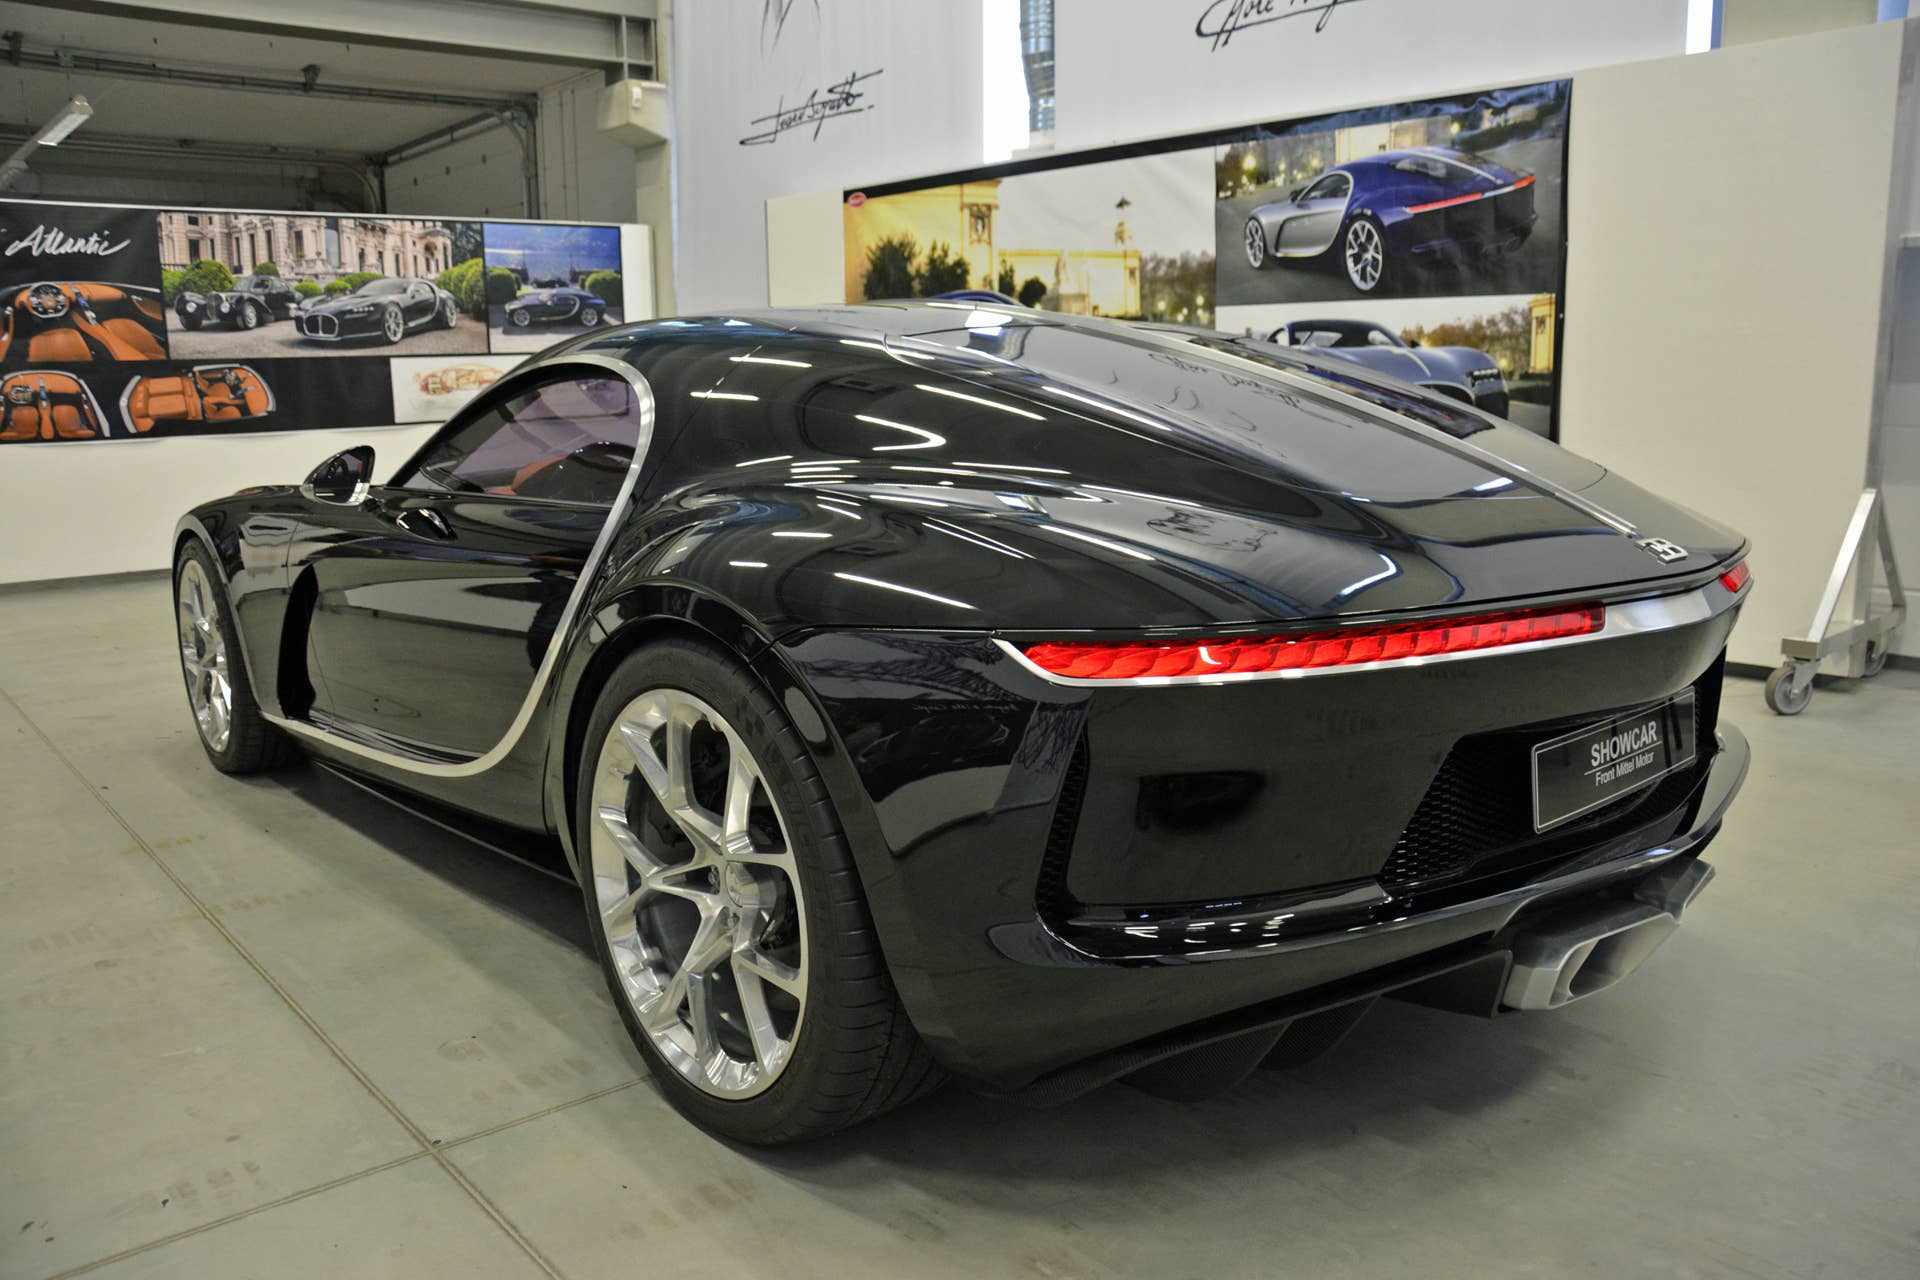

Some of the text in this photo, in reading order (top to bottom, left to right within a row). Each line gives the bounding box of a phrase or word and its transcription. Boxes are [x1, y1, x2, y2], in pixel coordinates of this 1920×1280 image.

[4, 224, 131, 257] Atlantic
[1591, 720, 1657, 767] SHOWCAR
[1595, 751, 1655, 786] Front Mittel Motor
